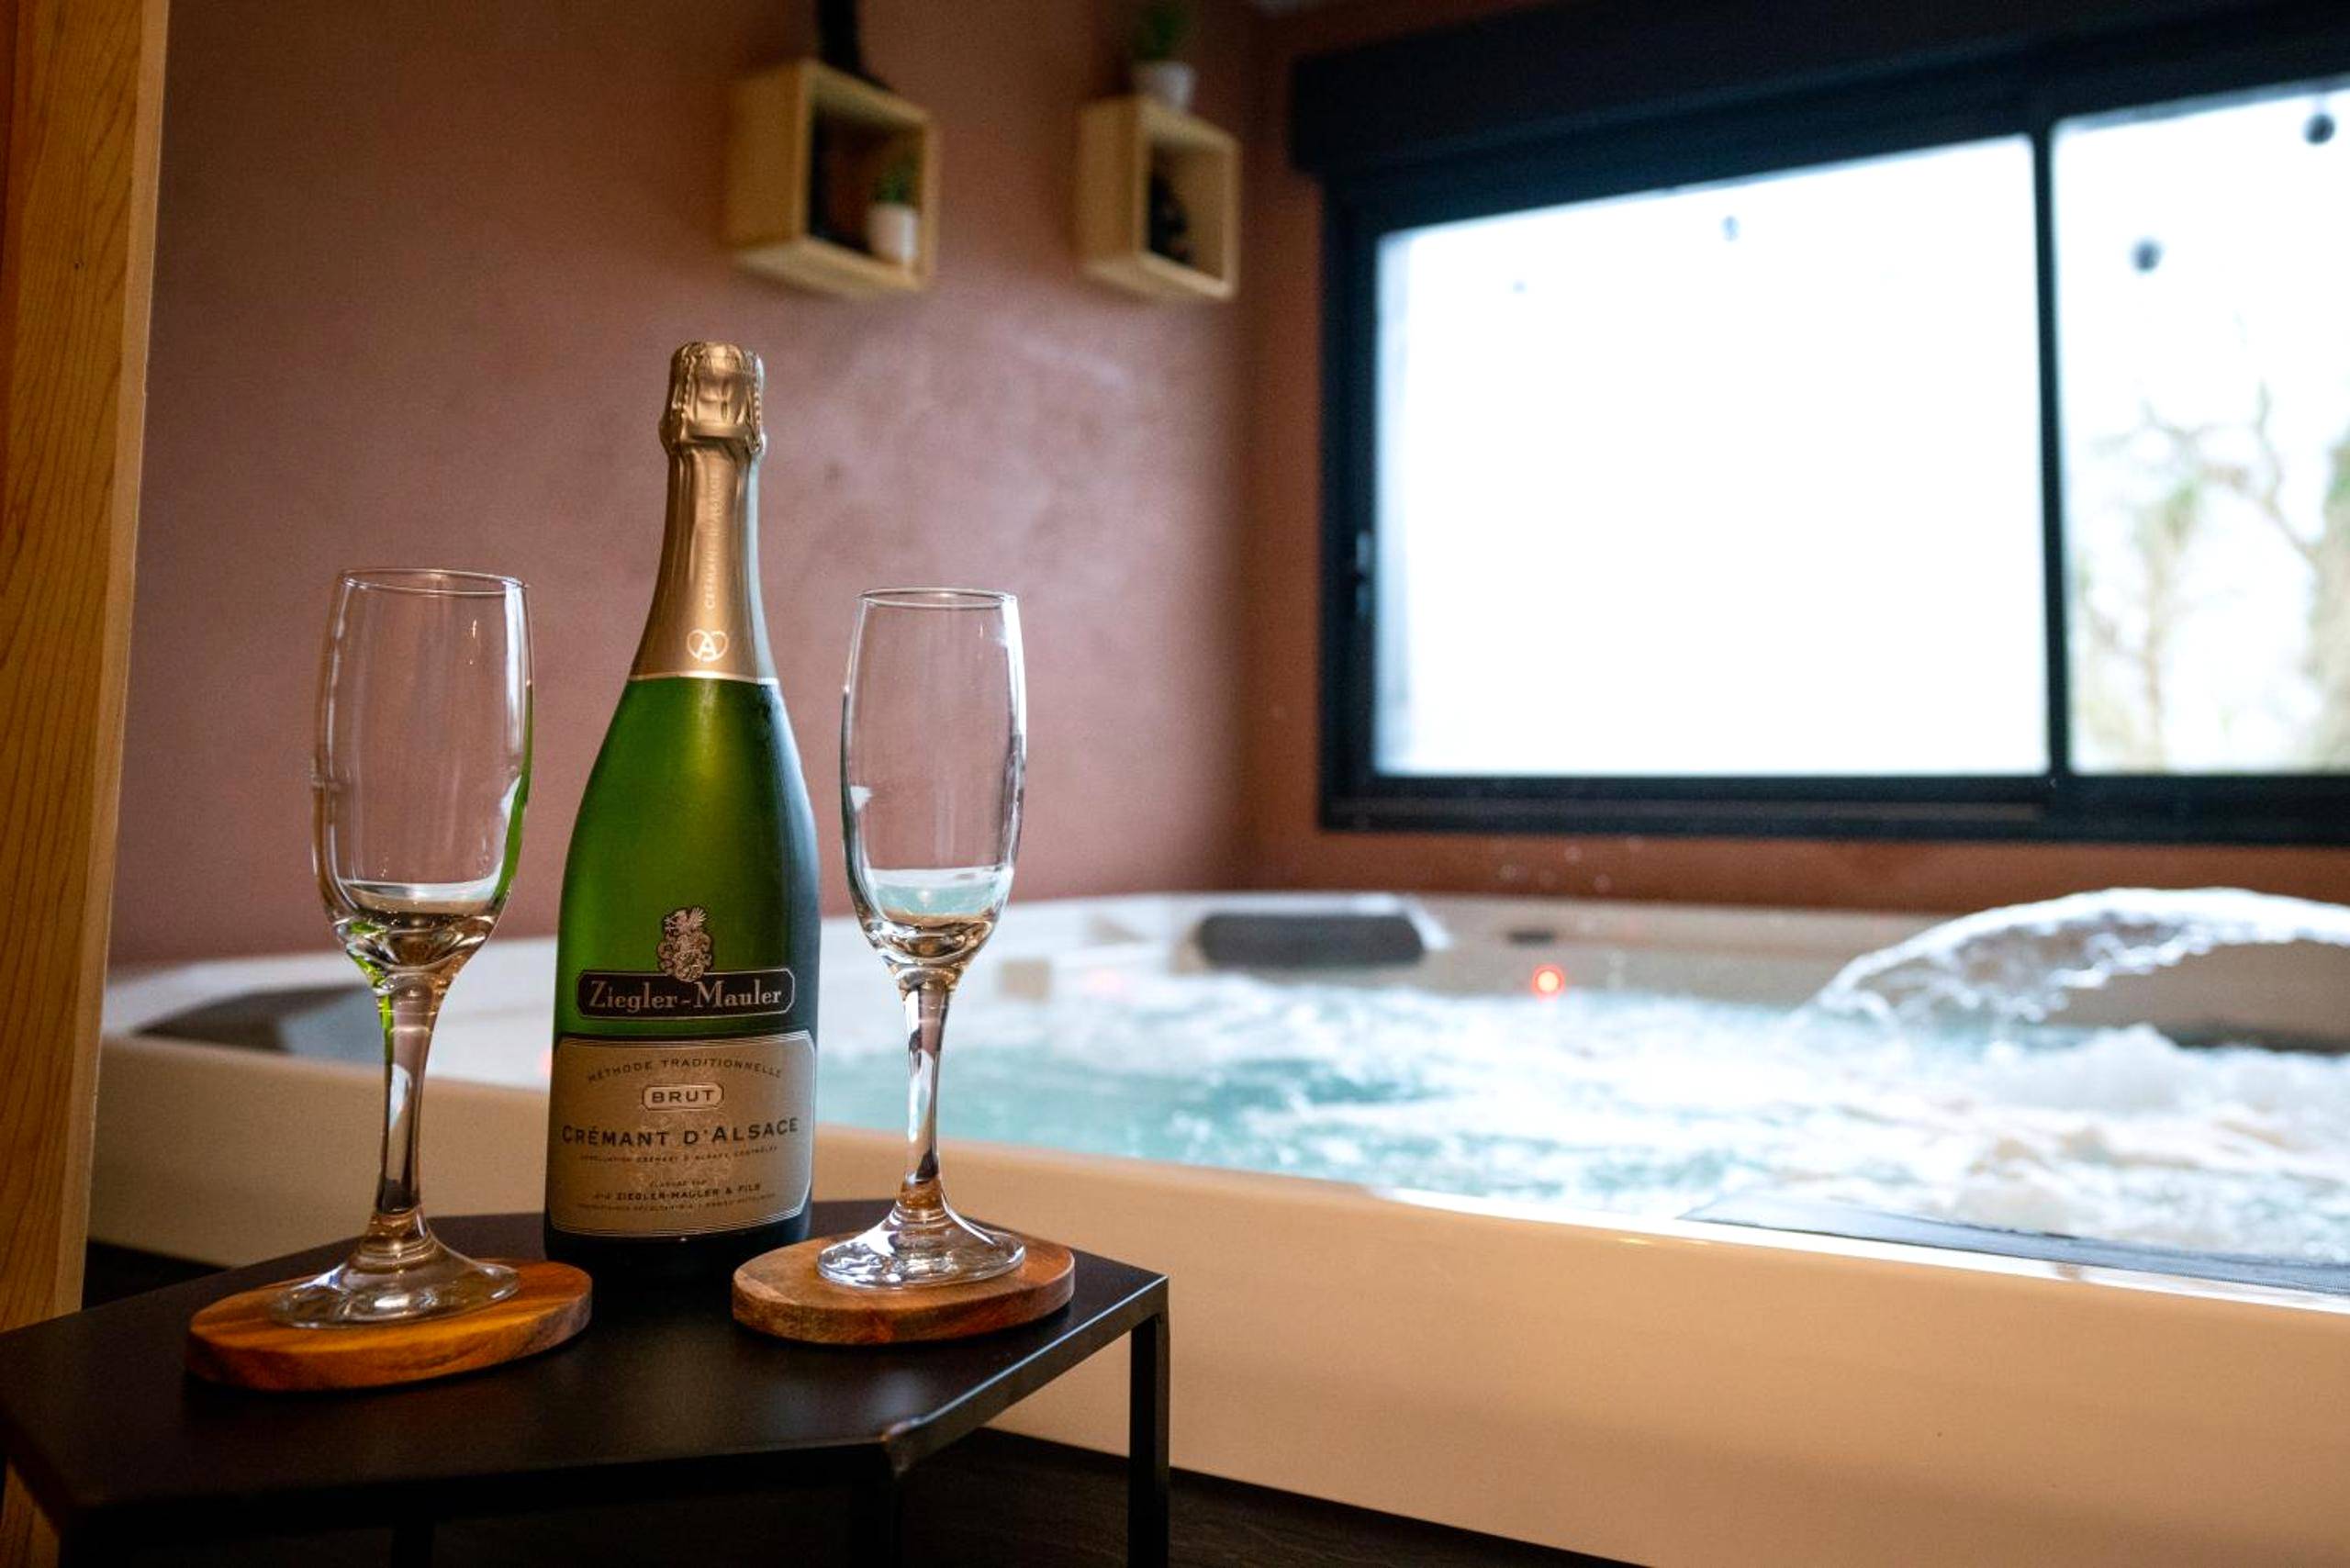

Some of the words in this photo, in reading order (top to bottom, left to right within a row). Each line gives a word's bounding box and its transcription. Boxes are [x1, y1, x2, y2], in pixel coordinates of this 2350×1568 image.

[588, 979, 782, 1013] Ziegler-Mauler
[660, 1057, 783, 1079] TRADITIONNELLE
[652, 1089, 715, 1103] BRUT
[561, 1124, 670, 1147] CRÉMANT
[683, 1116, 800, 1145] D'ALSACE
